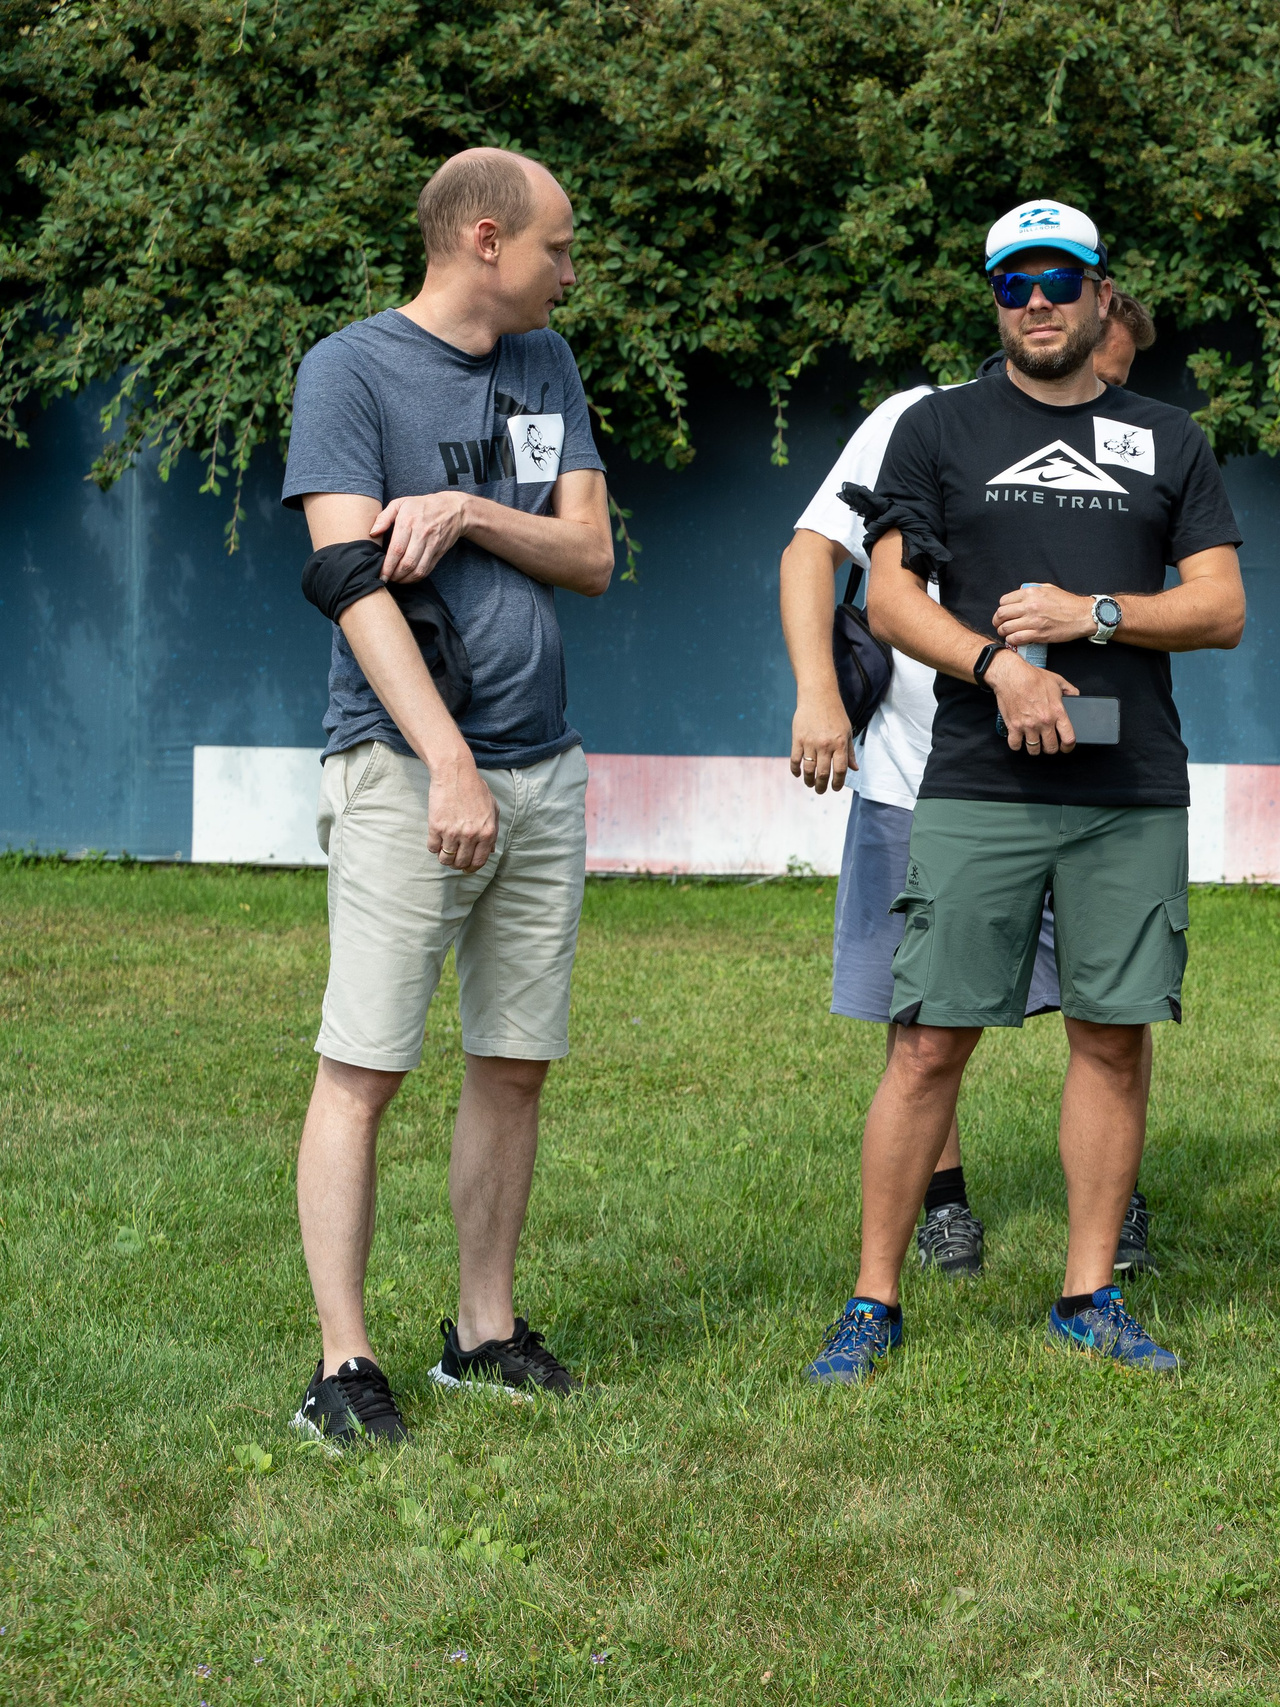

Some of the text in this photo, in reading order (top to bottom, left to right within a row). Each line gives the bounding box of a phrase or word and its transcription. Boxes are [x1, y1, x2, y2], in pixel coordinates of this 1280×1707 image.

[985, 489, 1130, 512] NIKE TRAIL
[855, 1302, 874, 1313] NIKE
